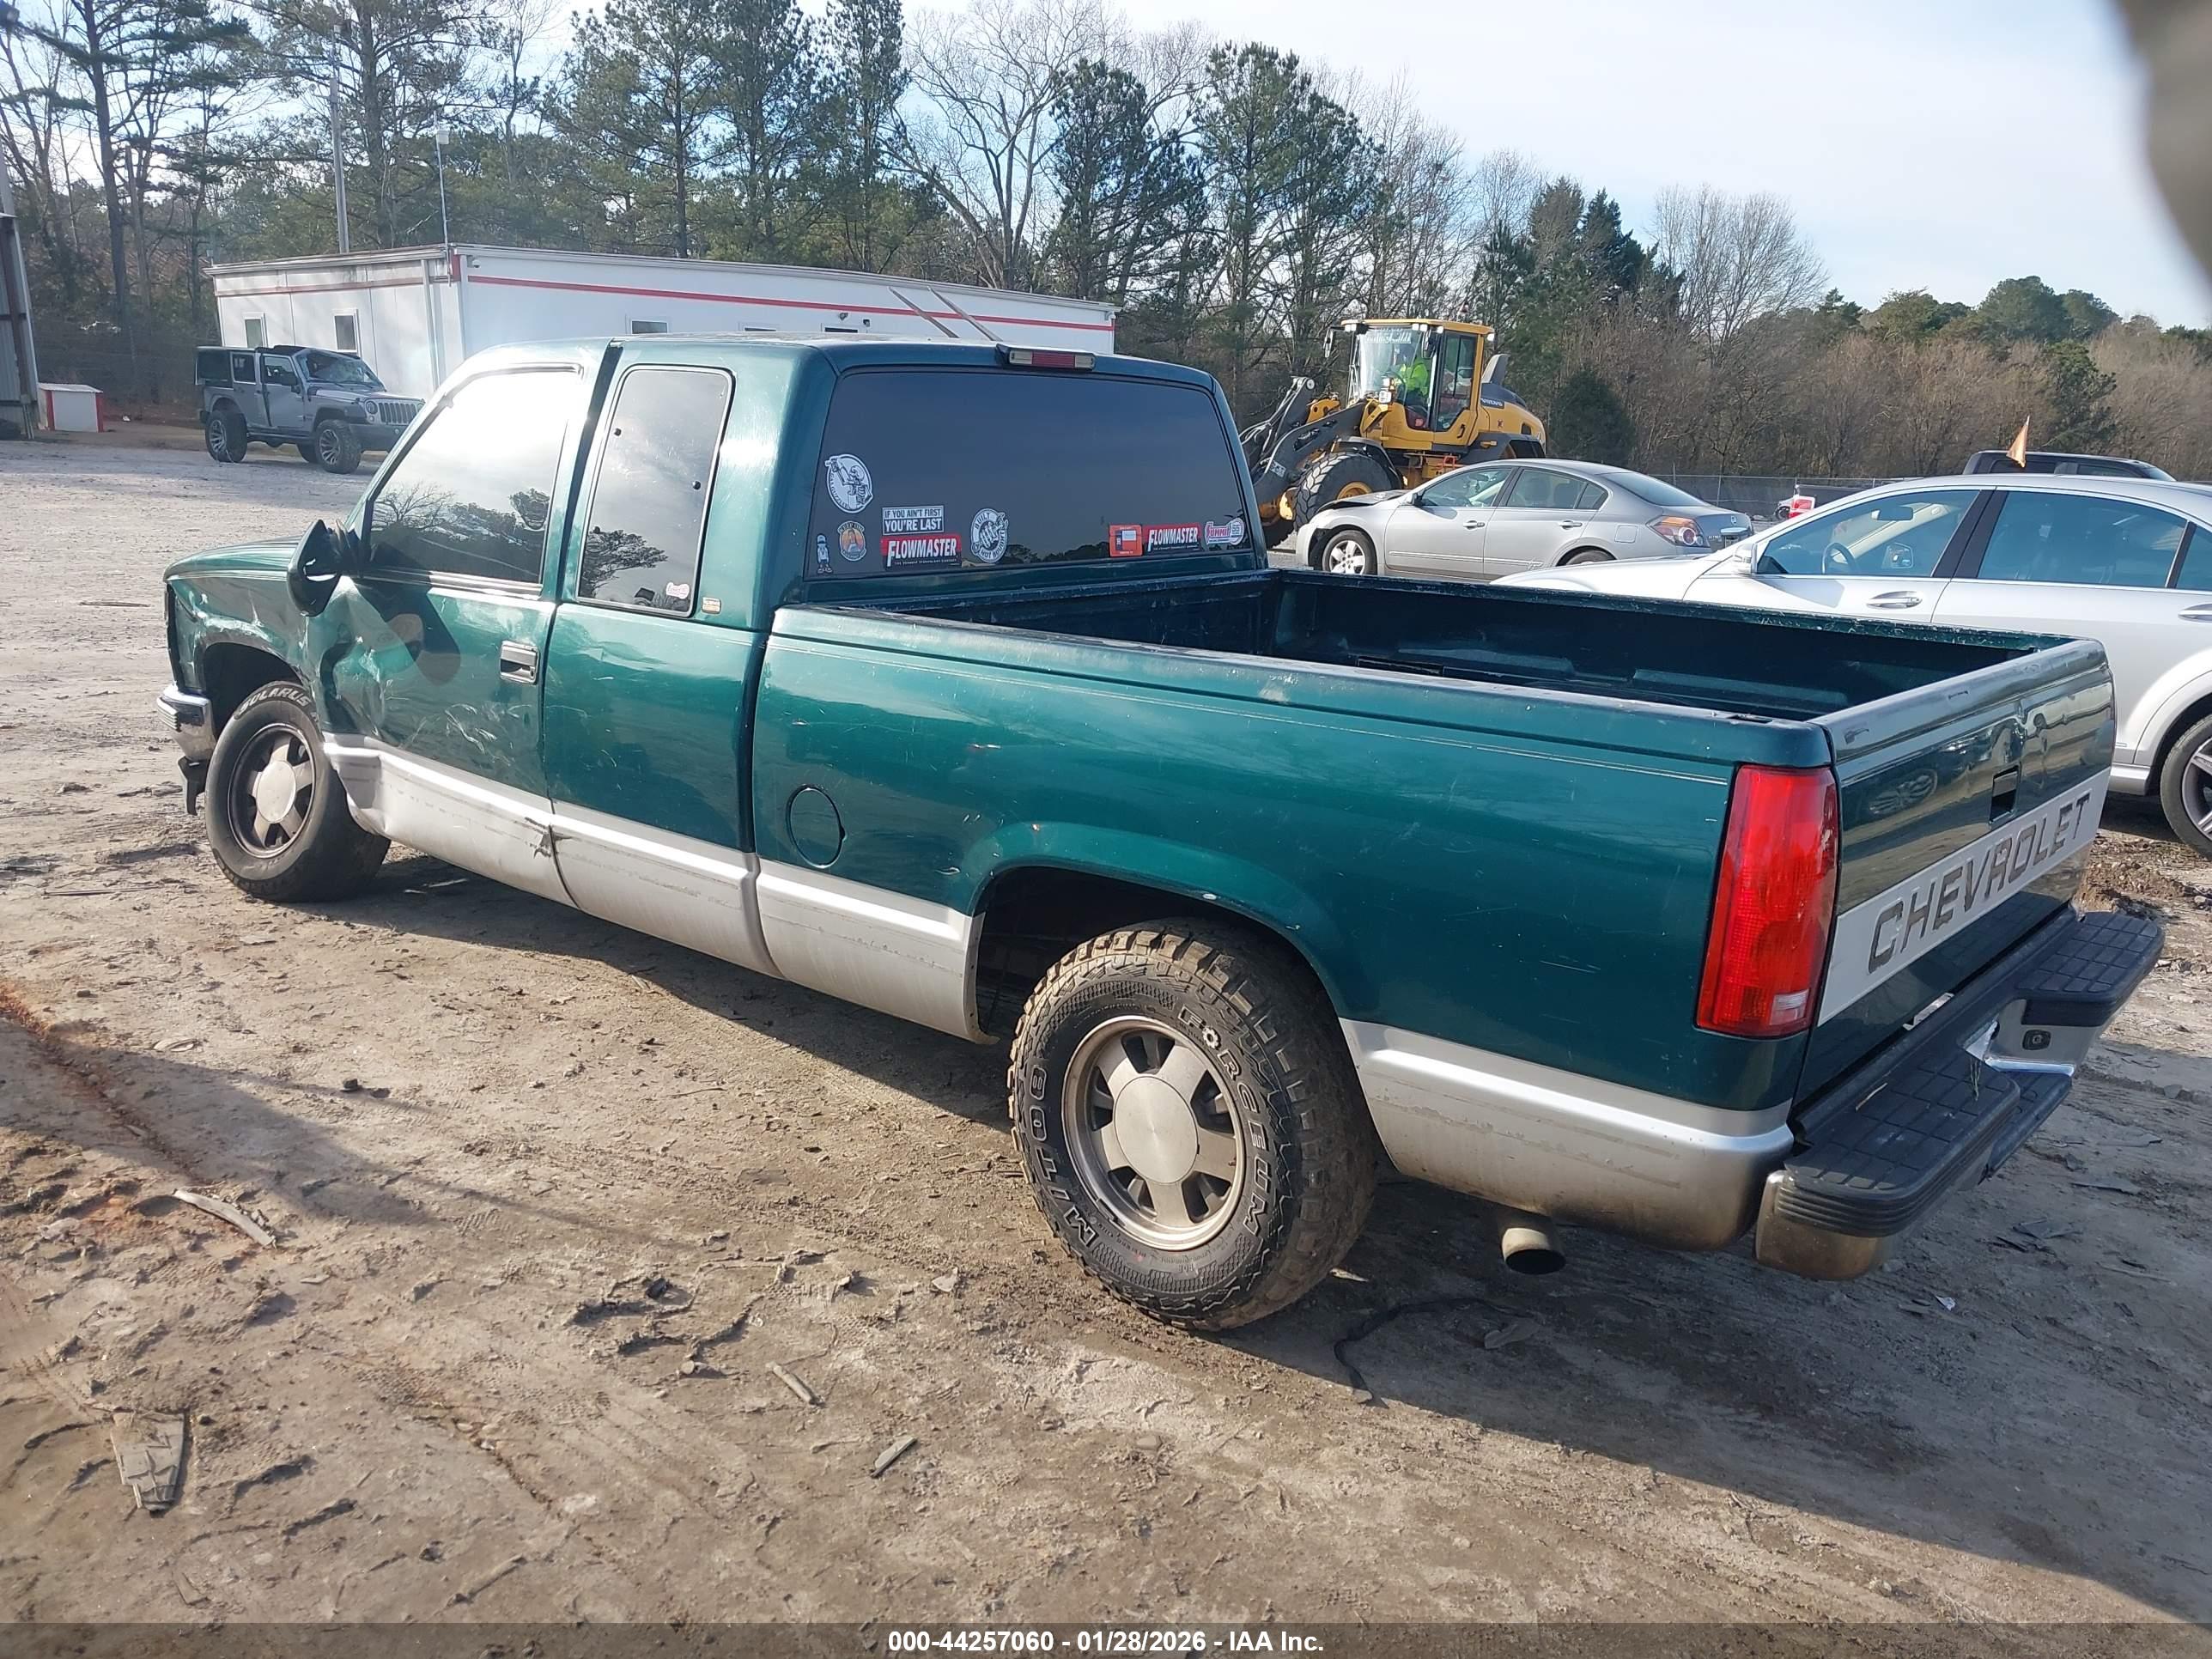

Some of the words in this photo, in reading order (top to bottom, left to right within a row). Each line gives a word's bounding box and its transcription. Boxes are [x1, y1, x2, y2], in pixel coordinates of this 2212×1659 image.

[884, 510, 891, 519] IF
[893, 509, 905, 519] YOU
[907, 509, 922, 518] AIN'T
[925, 508, 941, 518] FIRST
[884, 519, 919, 532] YOU'RE
[920, 518, 942, 531] LAST
[974, 512, 990, 530] BUILT
[1147, 526, 1199, 552] FLOWMASTER
[887, 538, 957, 568] FLOWMASTER
[1868, 790, 2092, 975] CHEVROLET
[1178, 1004, 1273, 1237] FORCEUM
